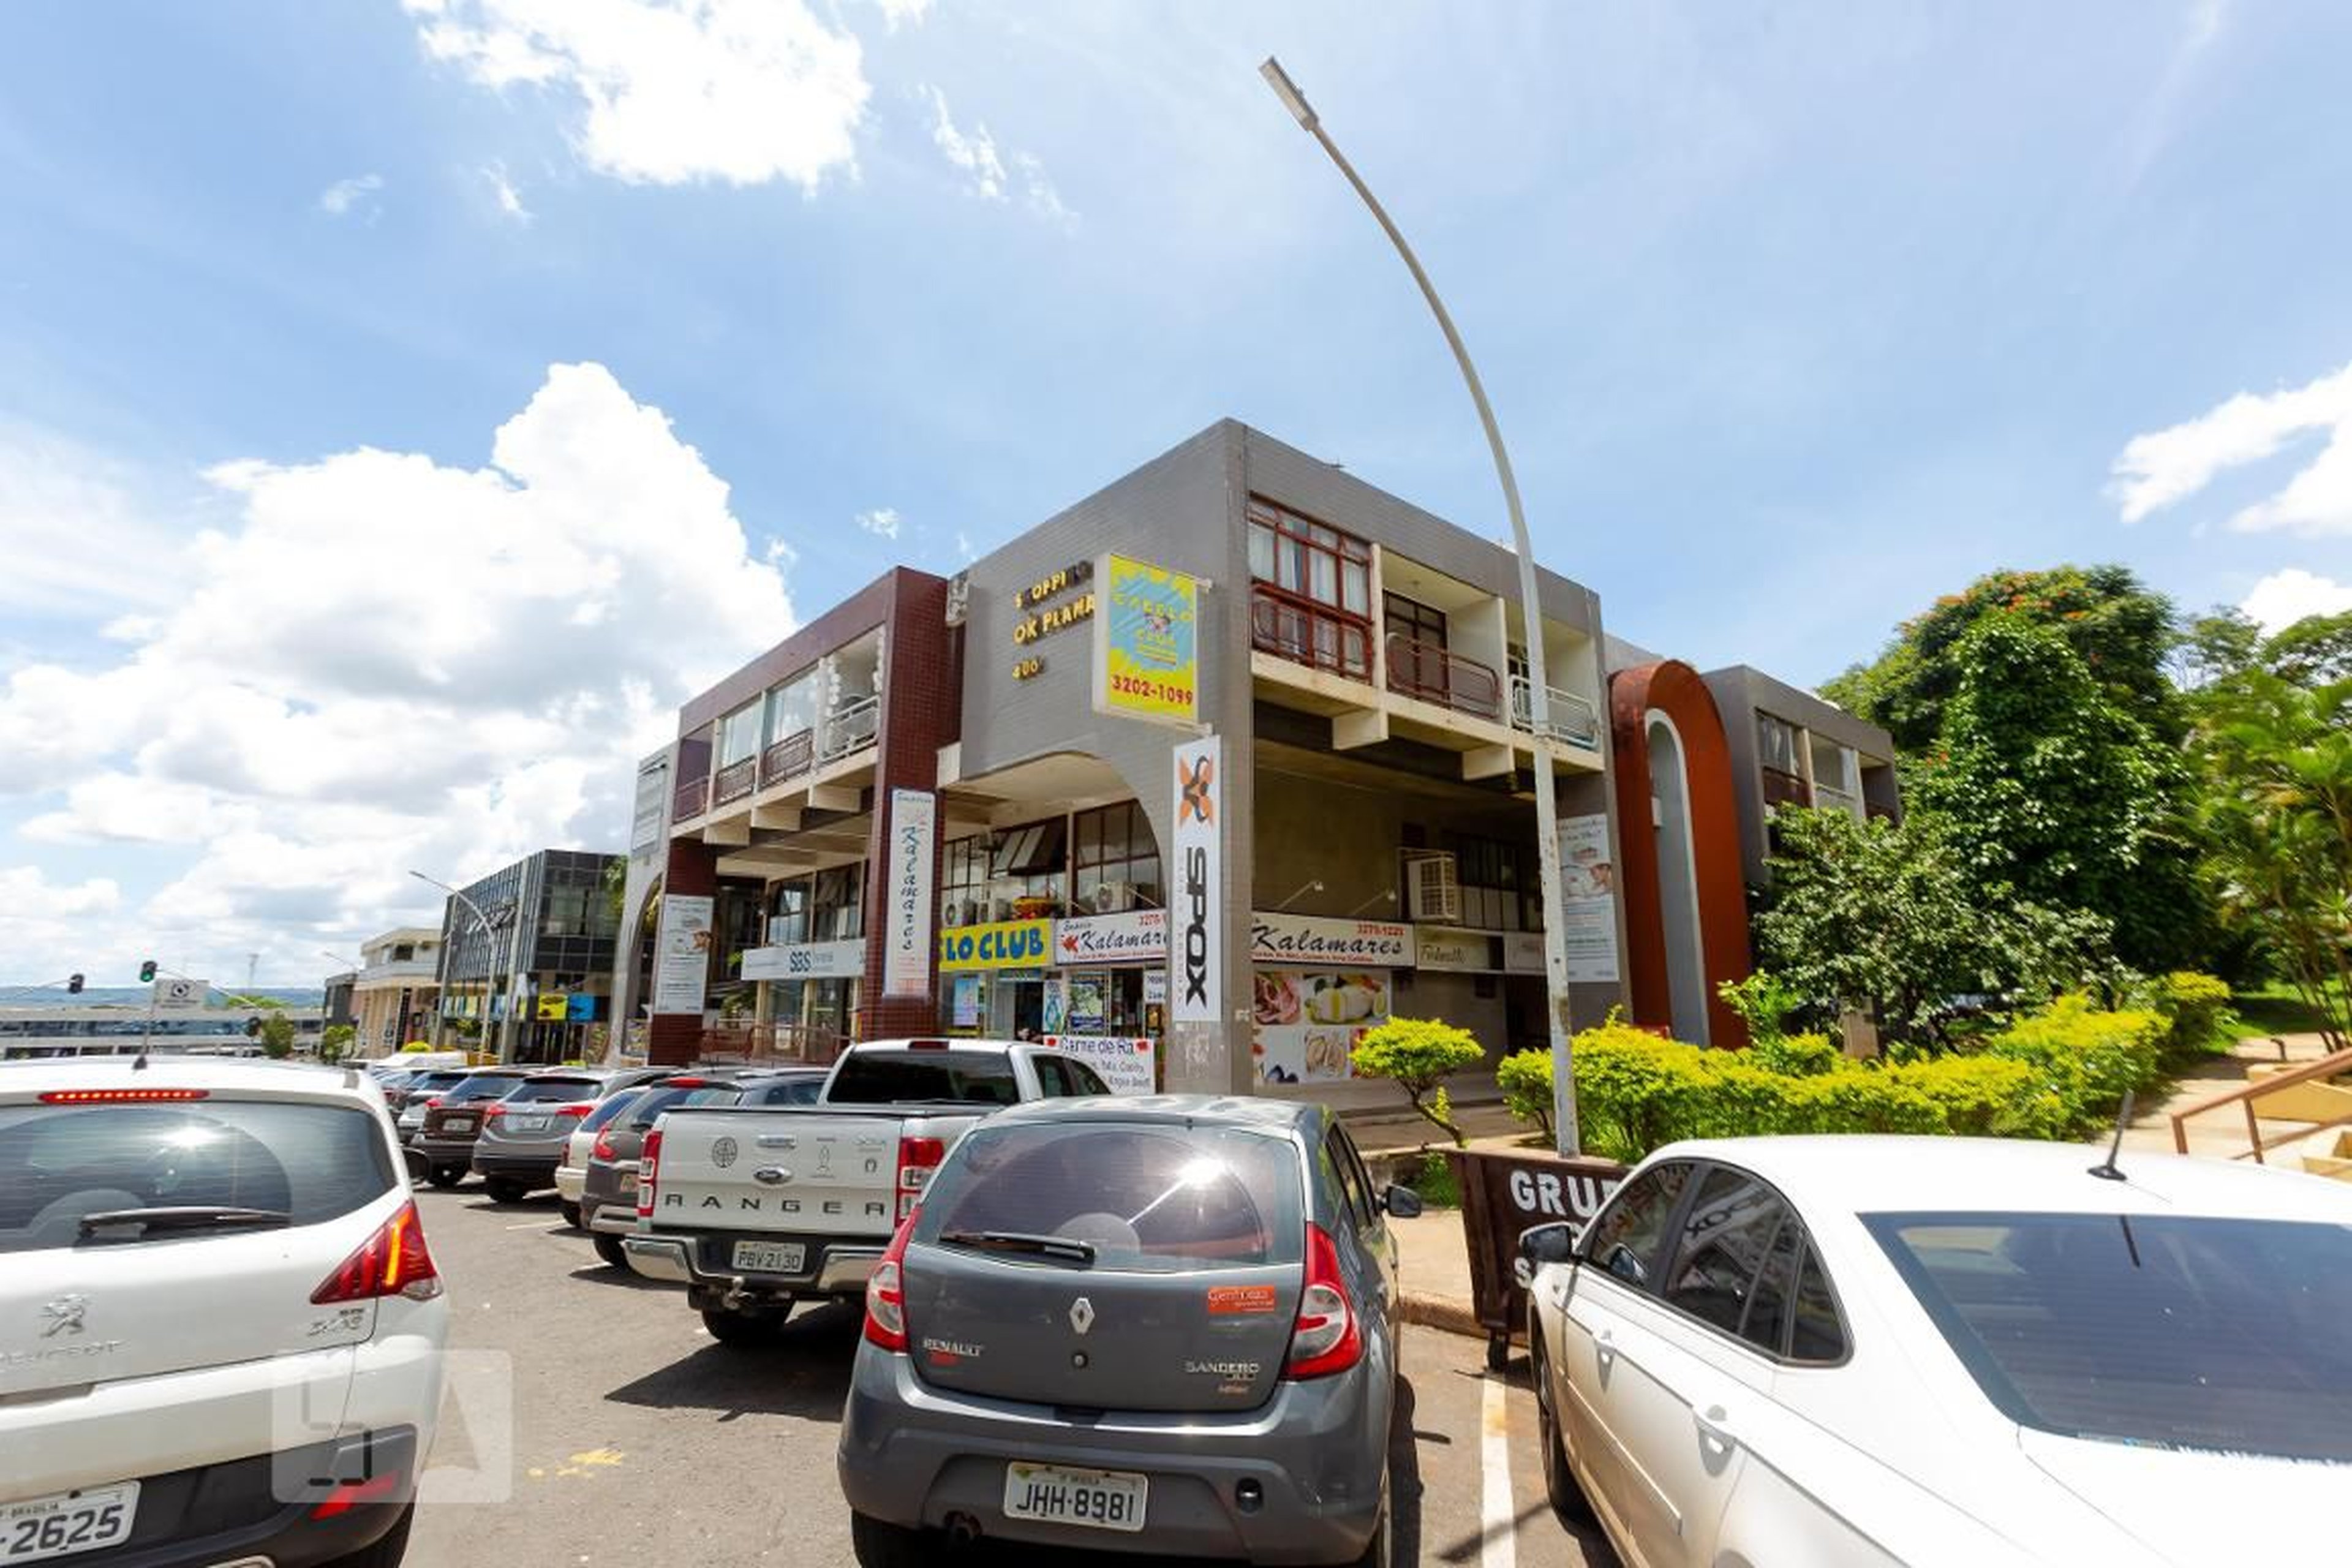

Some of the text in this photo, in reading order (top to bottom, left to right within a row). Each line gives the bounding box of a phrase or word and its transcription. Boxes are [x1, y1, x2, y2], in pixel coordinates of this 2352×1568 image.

[1112, 674, 1193, 705] 3202-1099
[946, 927, 1044, 961] LO CLUB
[1252, 924, 1403, 954] Kalamares
[665, 1193, 885, 1216] RANGER
[922, 1337, 985, 1357] RENAULT
[1186, 1361, 1261, 1373] SANDERO
